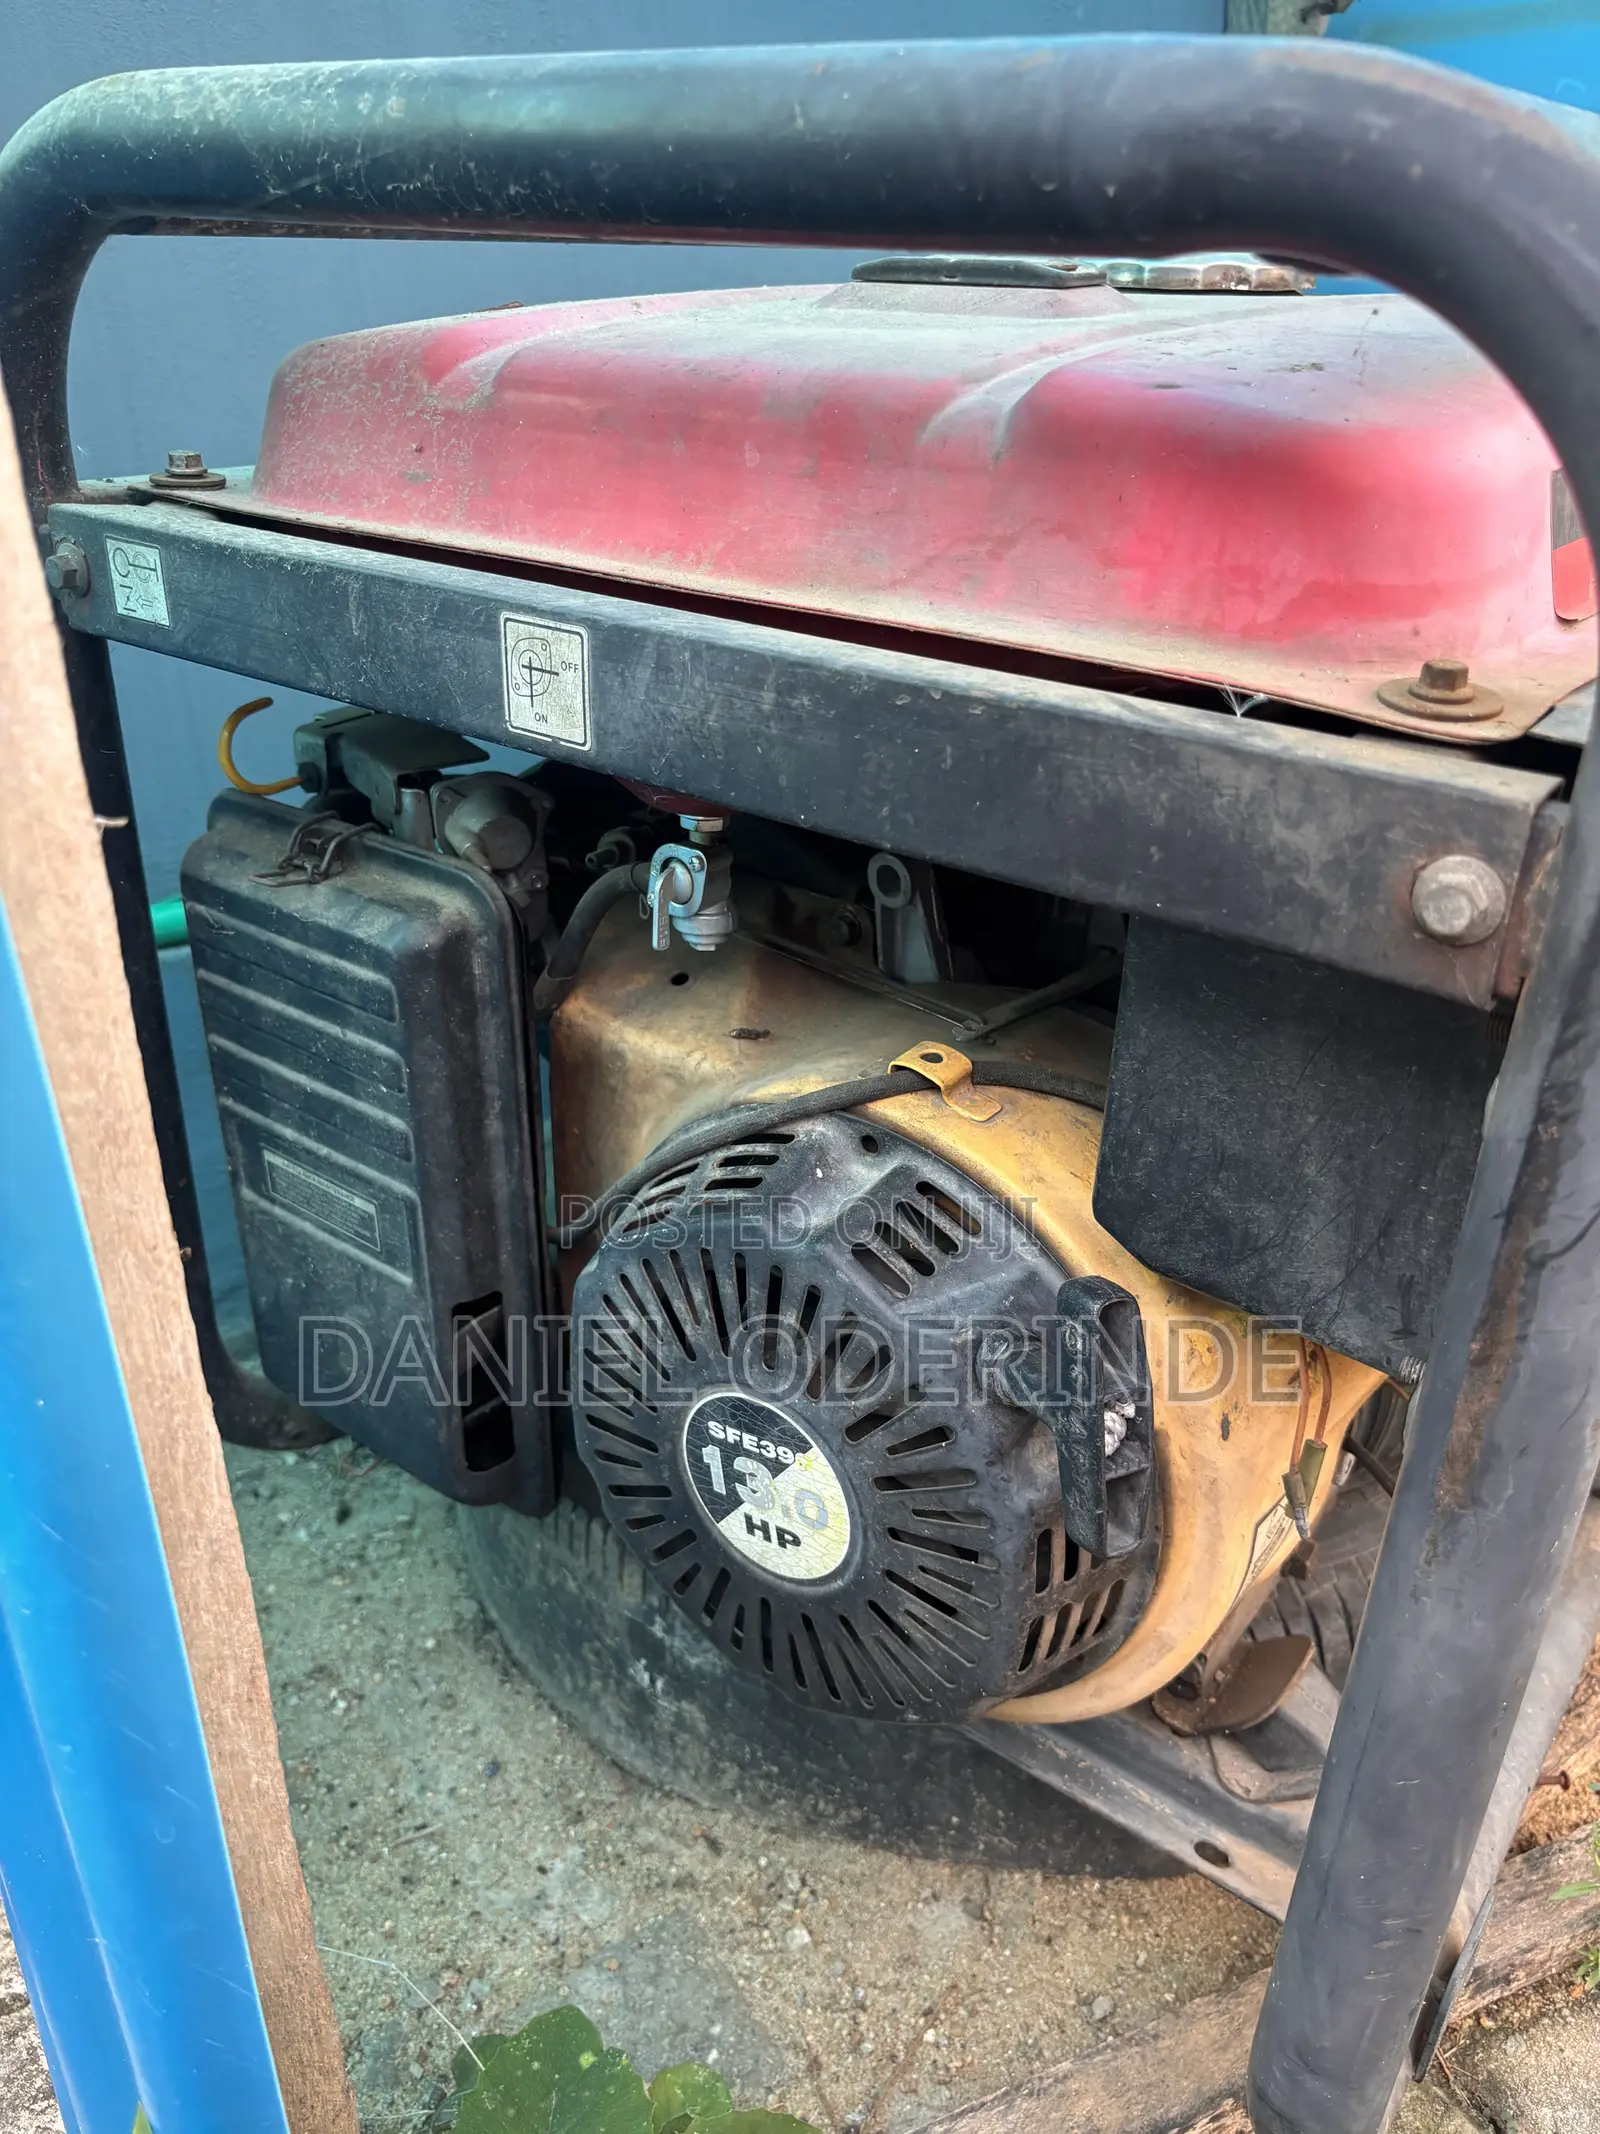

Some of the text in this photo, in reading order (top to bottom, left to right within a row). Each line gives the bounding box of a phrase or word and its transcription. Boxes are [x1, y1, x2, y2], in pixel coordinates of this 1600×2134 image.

[560, 660, 579, 673] OFF
[534, 712, 548, 724] ON
[744, 1512, 802, 1550] HP
